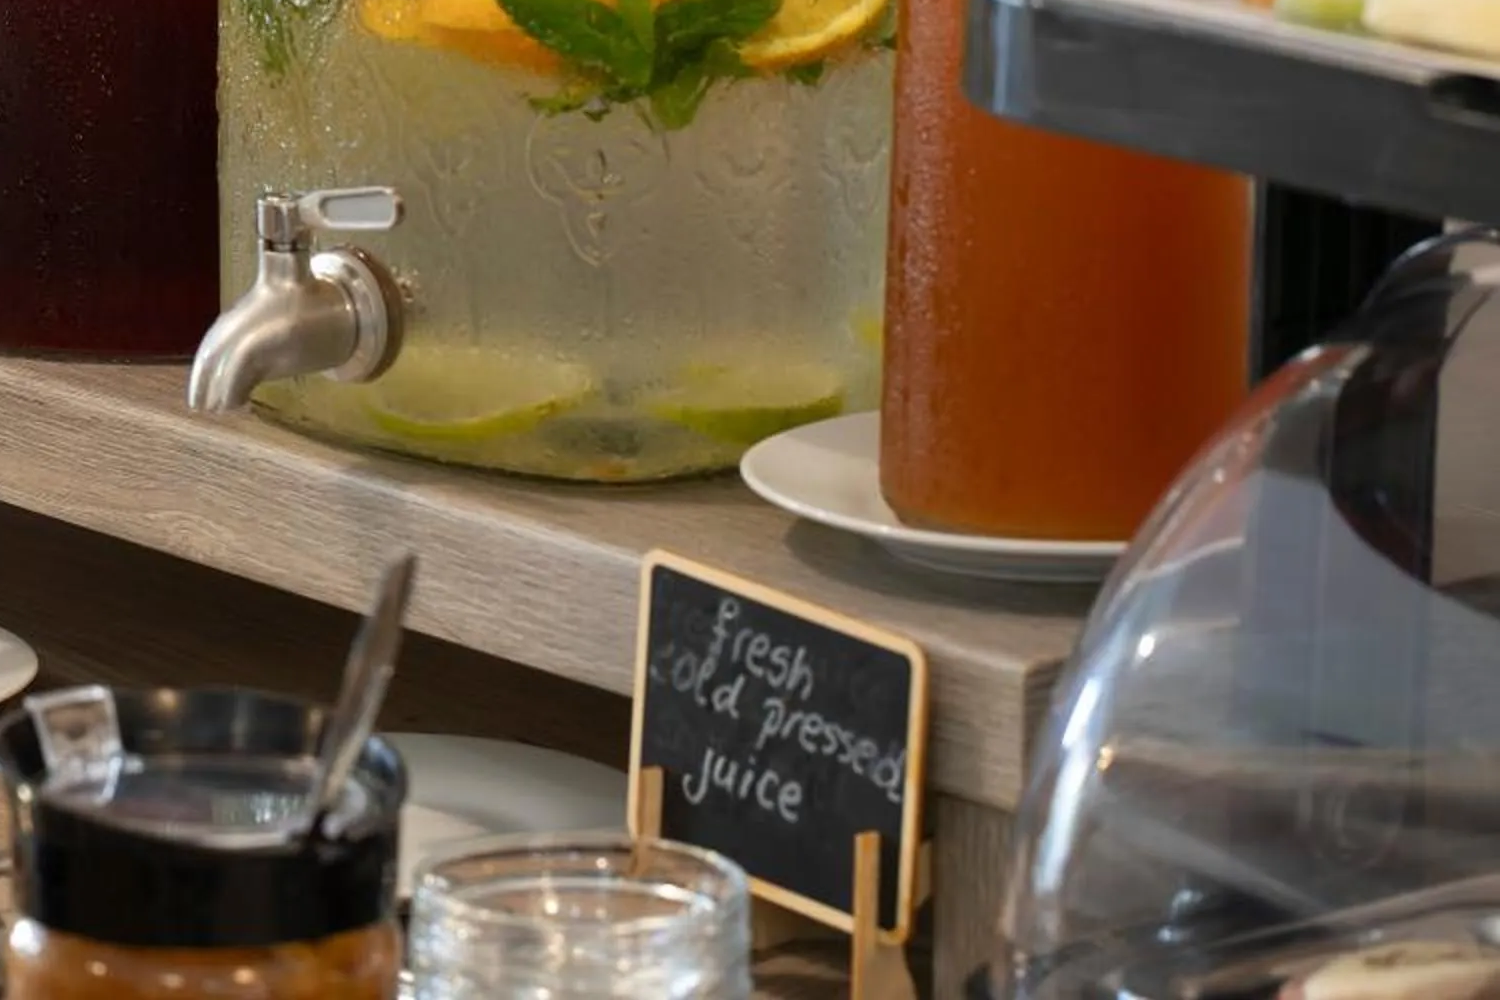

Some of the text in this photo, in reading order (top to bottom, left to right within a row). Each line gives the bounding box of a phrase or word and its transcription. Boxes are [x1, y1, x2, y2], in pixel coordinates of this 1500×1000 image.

[709, 597, 816, 701] fresh
[682, 747, 803, 822] juice
[754, 697, 906, 804] pressed
